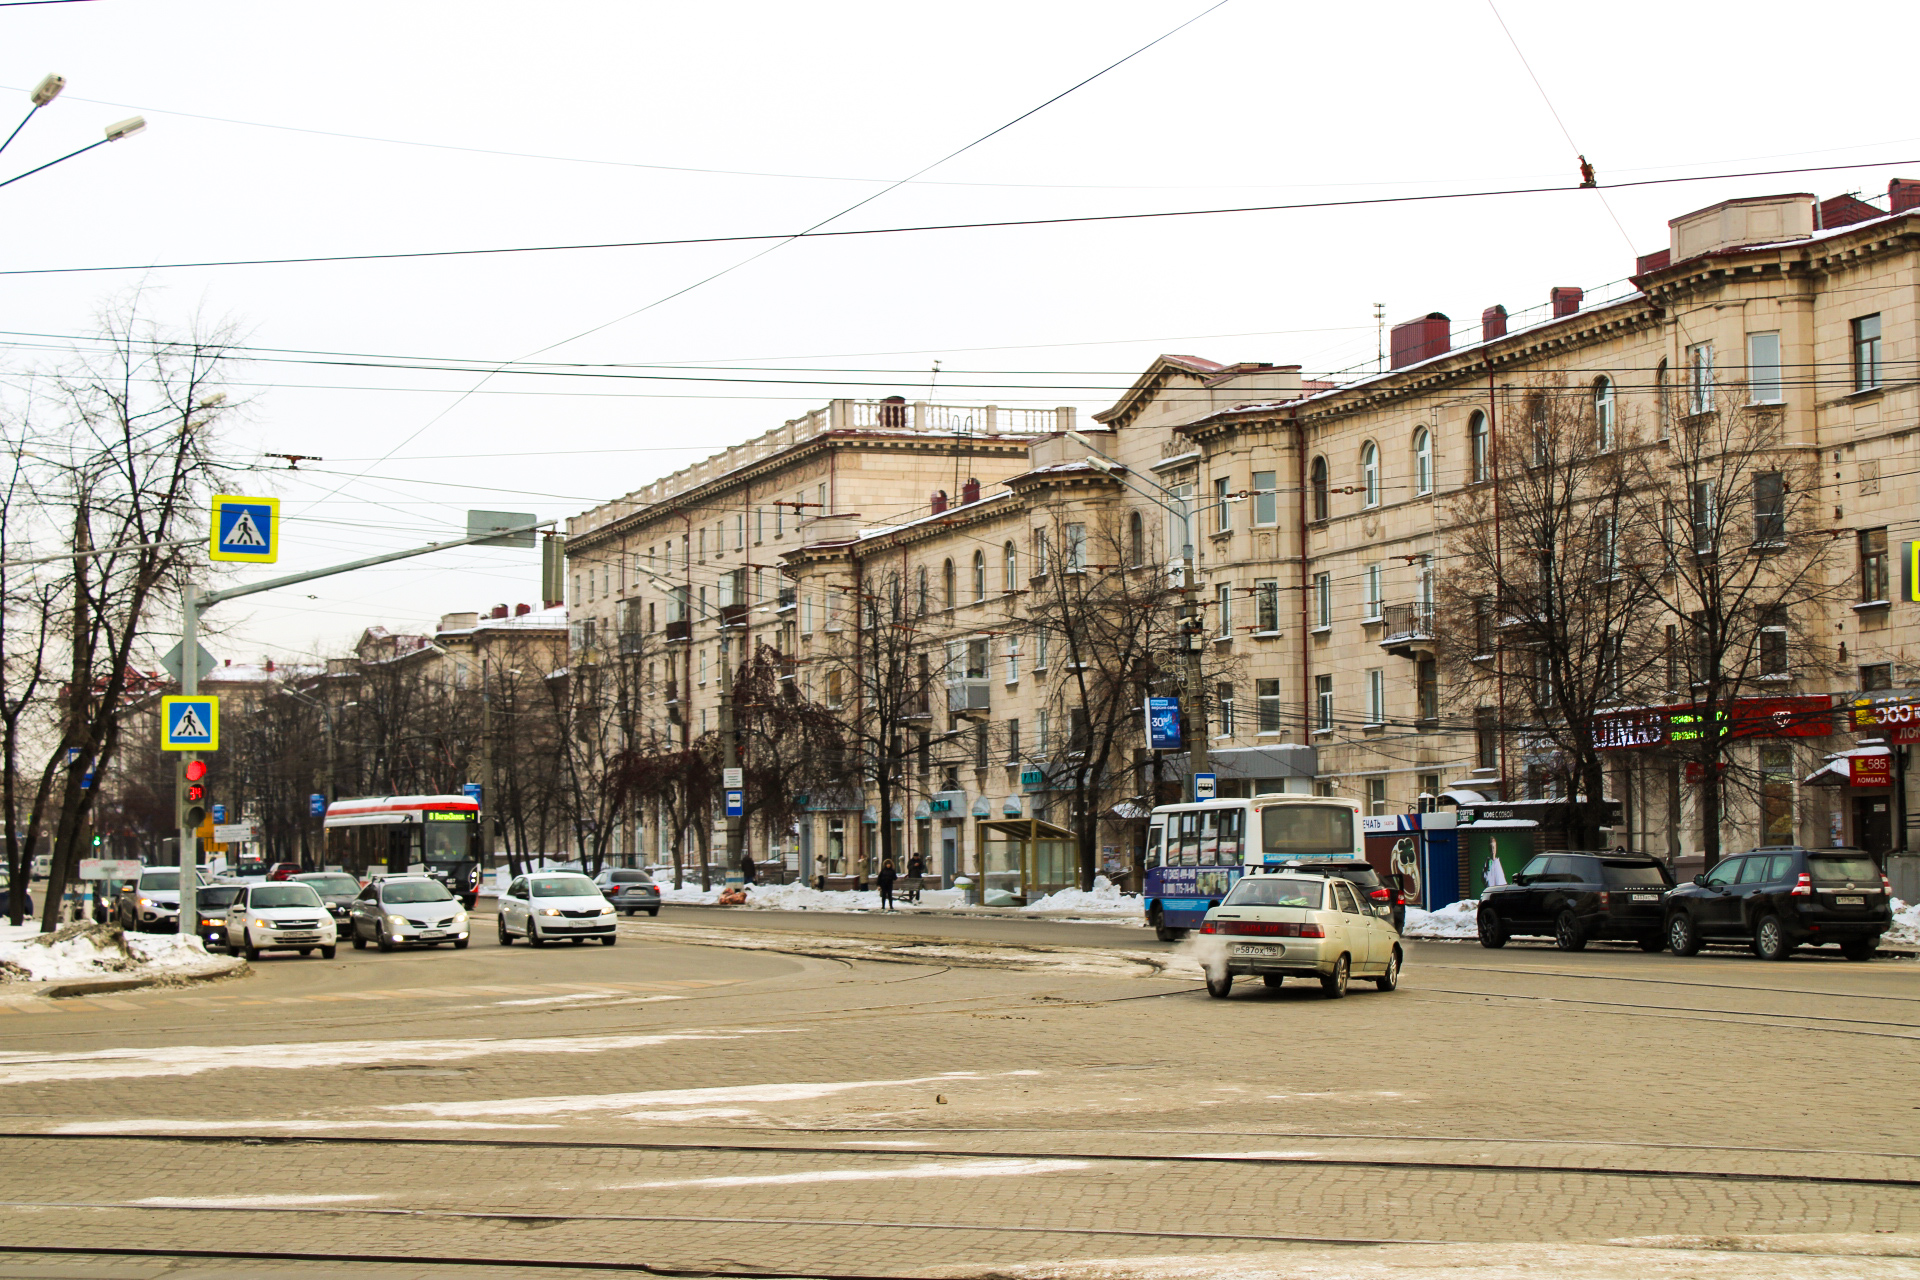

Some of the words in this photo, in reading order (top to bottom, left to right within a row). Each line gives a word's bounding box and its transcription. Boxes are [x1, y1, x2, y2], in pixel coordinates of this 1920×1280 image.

[1876, 696, 1912, 724] 585
[1151, 717, 1164, 727] 30
[1867, 758, 1886, 769] 585
[190, 786, 202, 800] 34
[1483, 811, 1495, 819] КОФЕ
[1235, 945, 1264, 954] Р587ОХ
